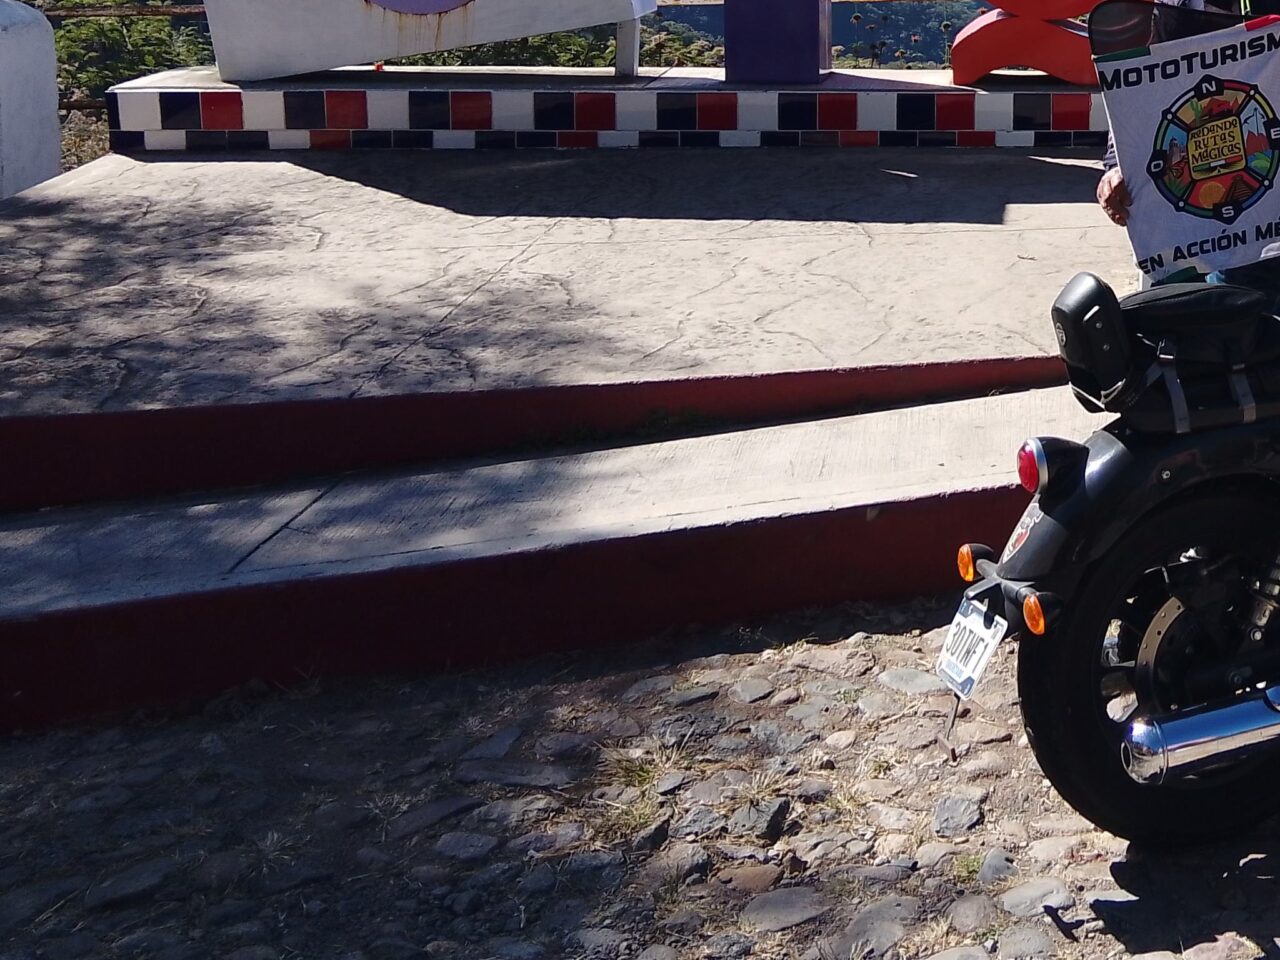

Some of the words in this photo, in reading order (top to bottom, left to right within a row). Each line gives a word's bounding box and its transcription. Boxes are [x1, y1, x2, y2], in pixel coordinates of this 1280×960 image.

[1202, 81, 1216, 94] N
[1151, 160, 1163, 172] O
[1222, 206, 1234, 217] S
[1138, 254, 1164, 275] EN
[1173, 229, 1247, 263] ACCIÓN
